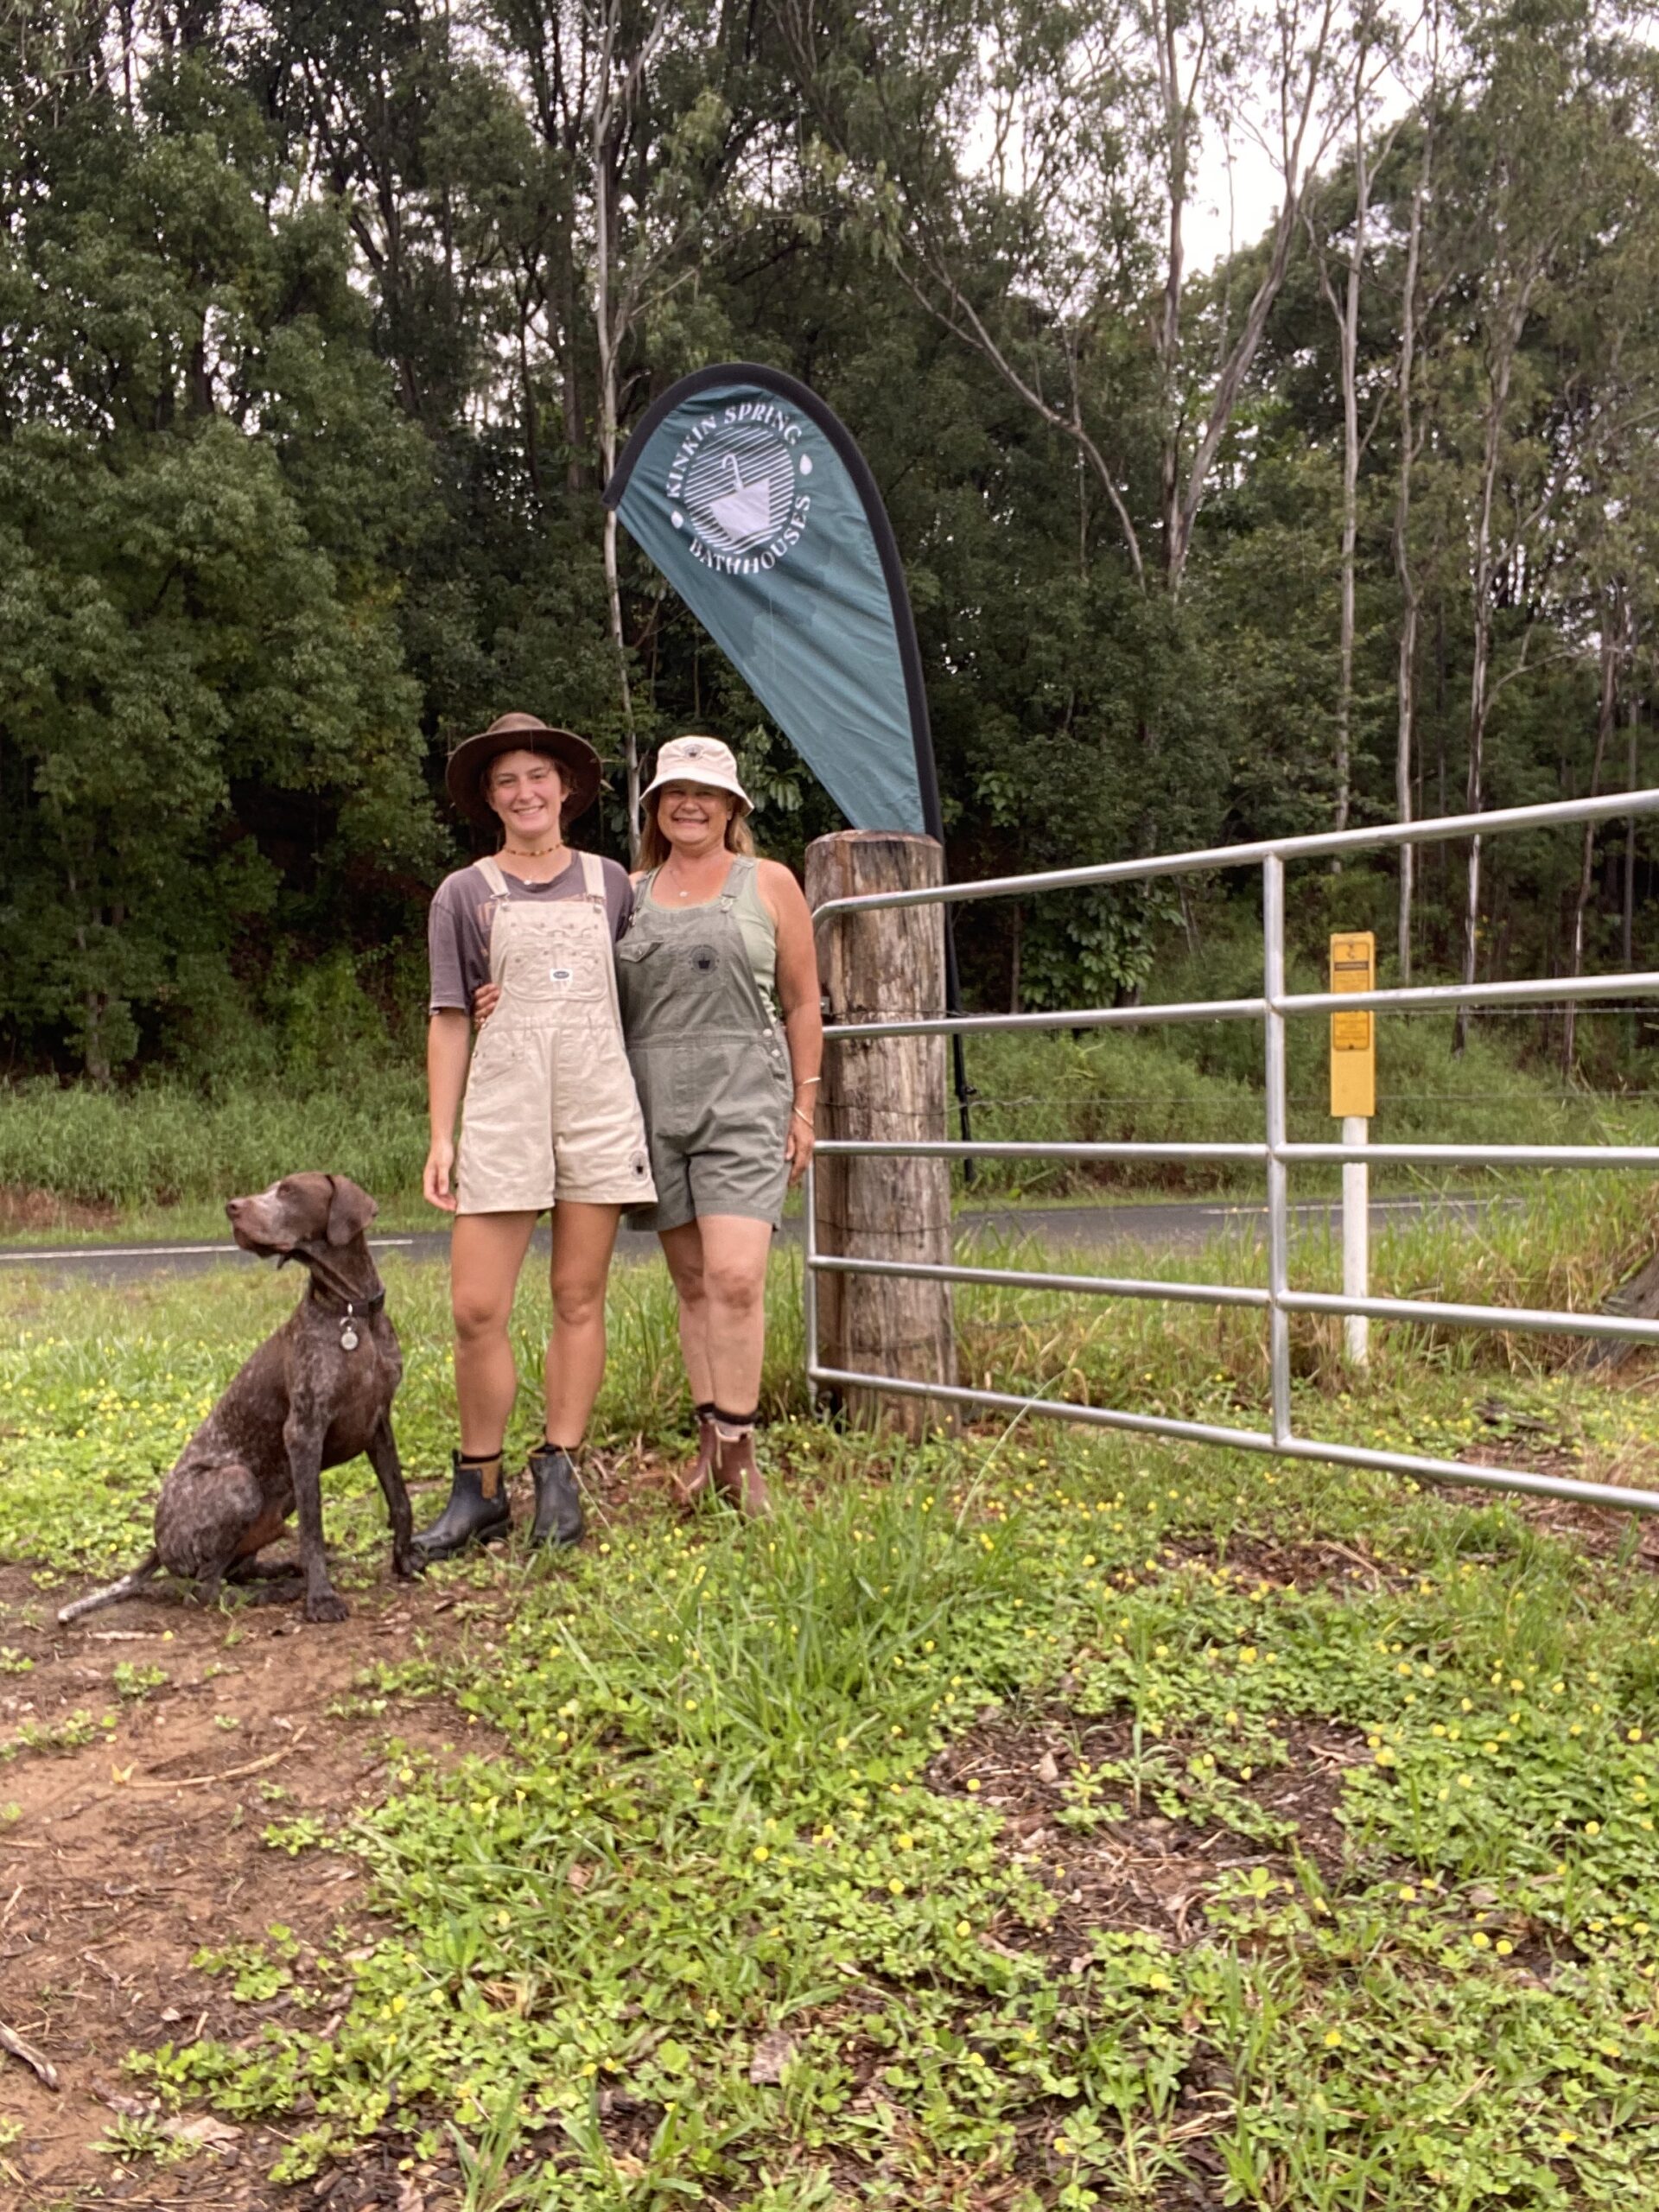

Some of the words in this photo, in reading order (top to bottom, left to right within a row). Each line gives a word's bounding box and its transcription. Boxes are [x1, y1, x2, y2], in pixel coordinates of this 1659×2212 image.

[666, 416, 717, 499] KINKIN
[723, 403, 802, 446] SPRING
[689, 494, 811, 575] BATHHOUSES
